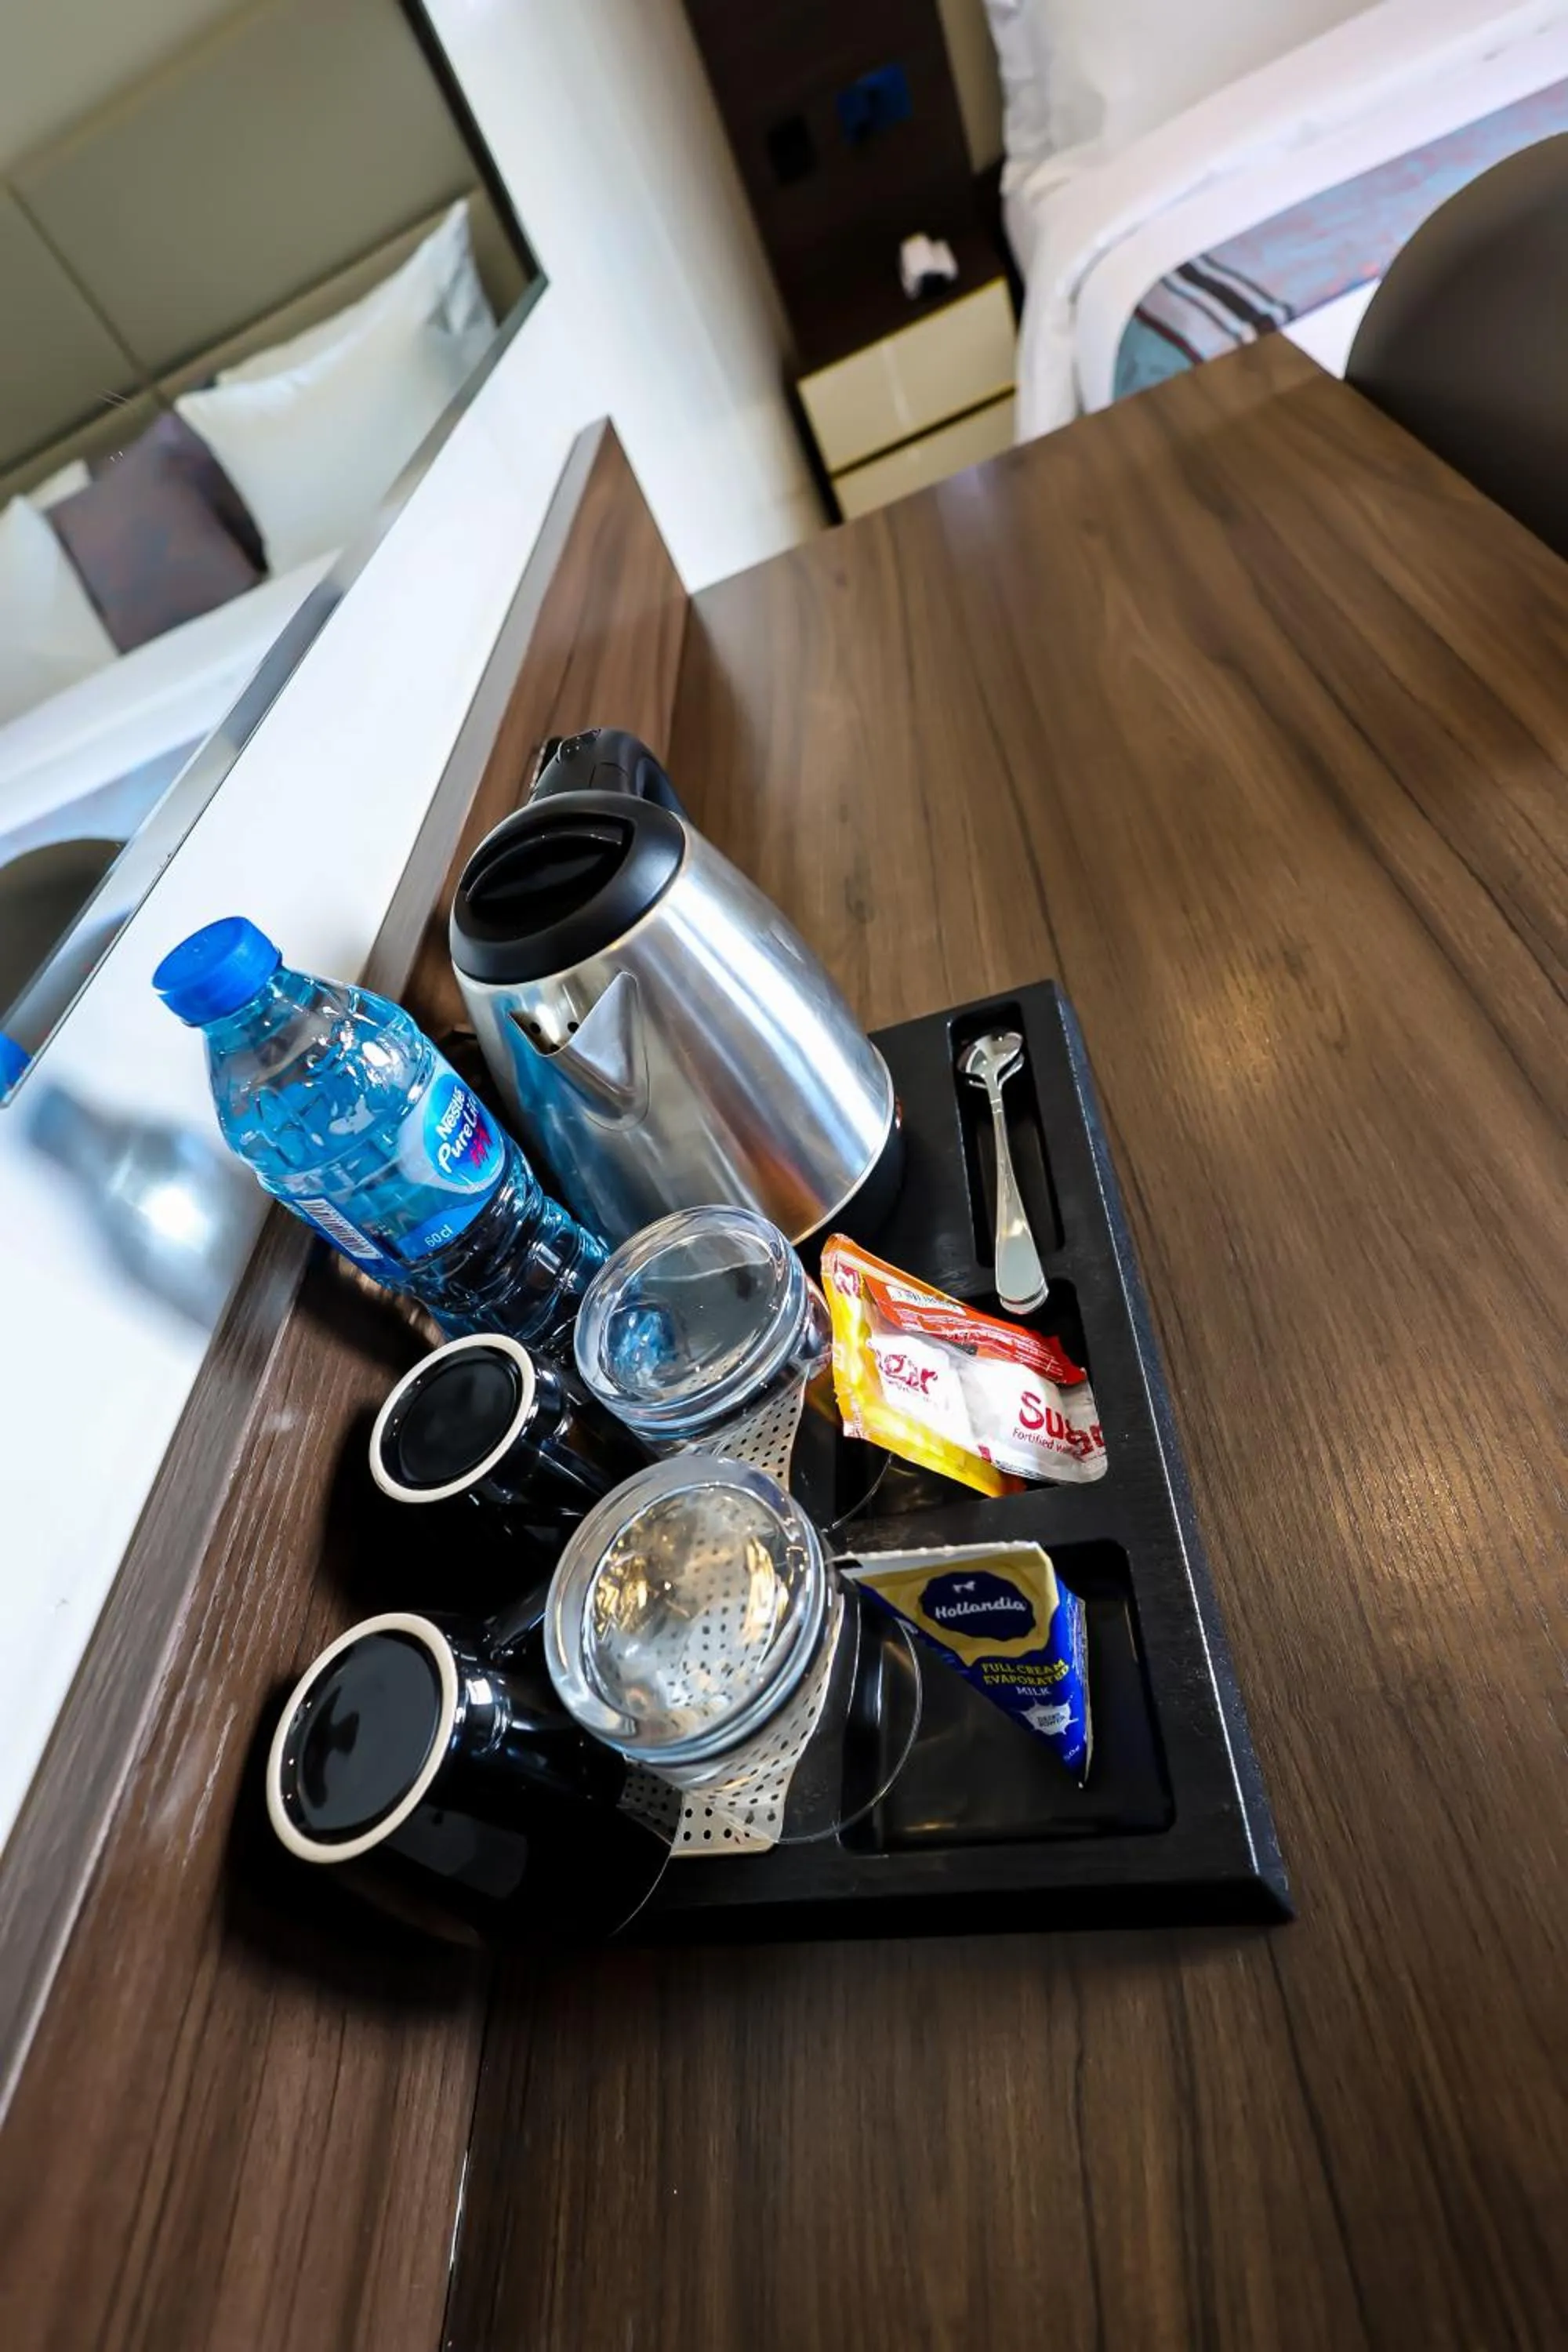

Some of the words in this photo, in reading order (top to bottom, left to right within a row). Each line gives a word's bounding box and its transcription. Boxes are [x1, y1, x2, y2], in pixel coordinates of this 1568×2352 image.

[437, 1123, 474, 1174] Pure
[424, 1232, 442, 1247] 60
[1012, 1427, 1054, 1450] Fortified
[935, 1596, 1026, 1619] Hollandia
[981, 1662, 1015, 1674] FULL
[1015, 1686, 1052, 1696] MILK
